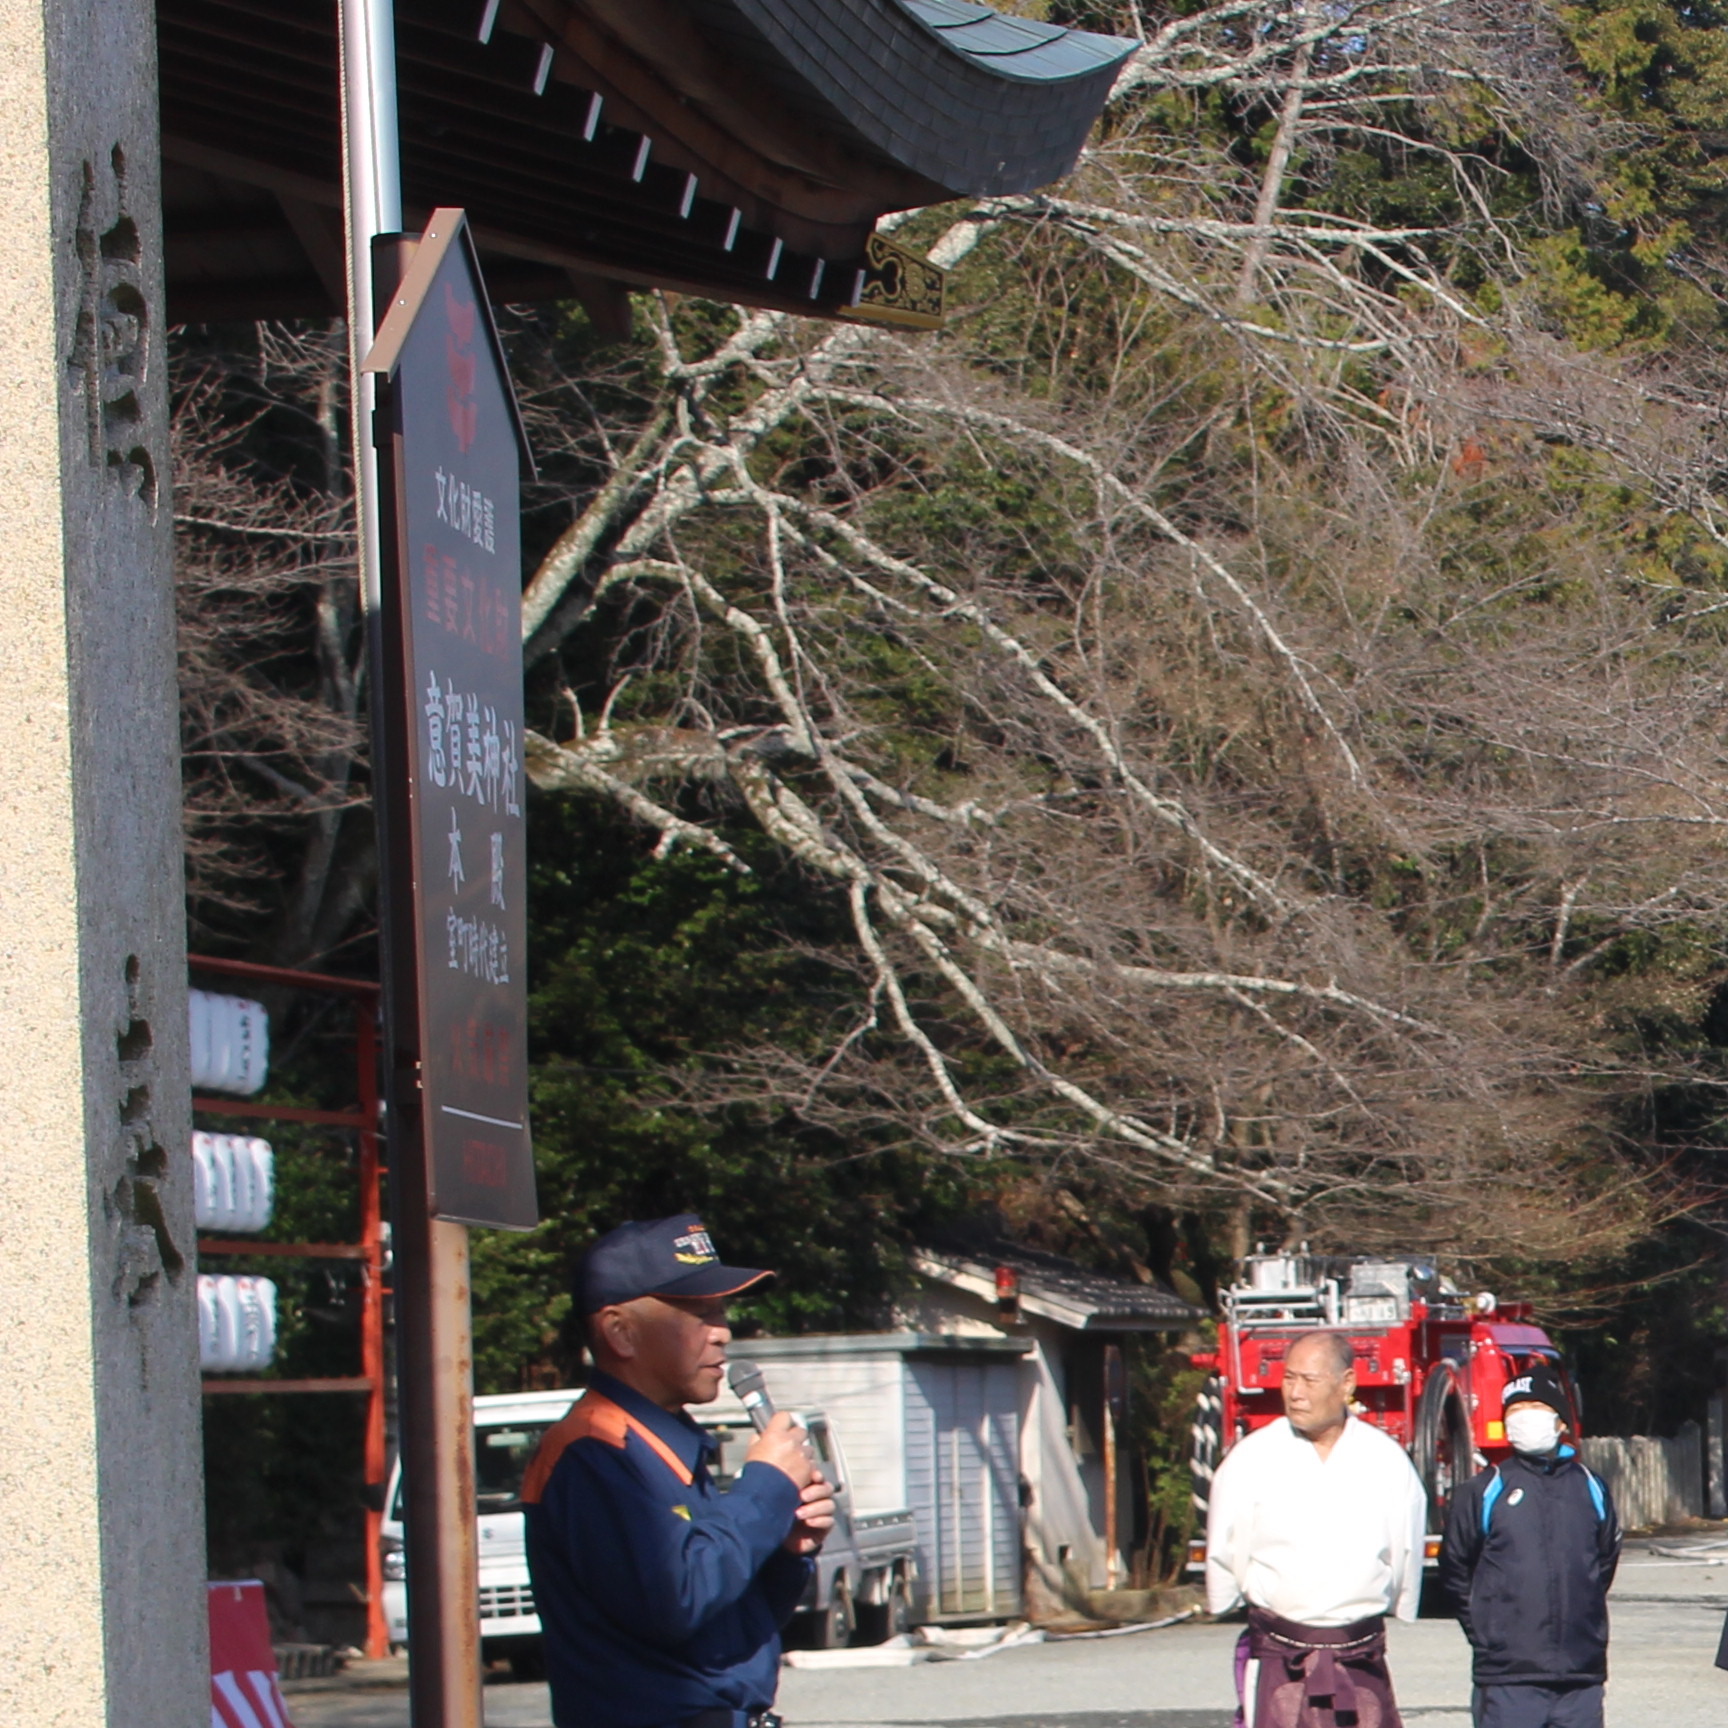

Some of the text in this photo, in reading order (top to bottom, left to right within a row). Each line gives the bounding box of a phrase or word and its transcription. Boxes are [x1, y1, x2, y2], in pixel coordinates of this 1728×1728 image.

[425, 669, 520, 818] 意賀美神社
